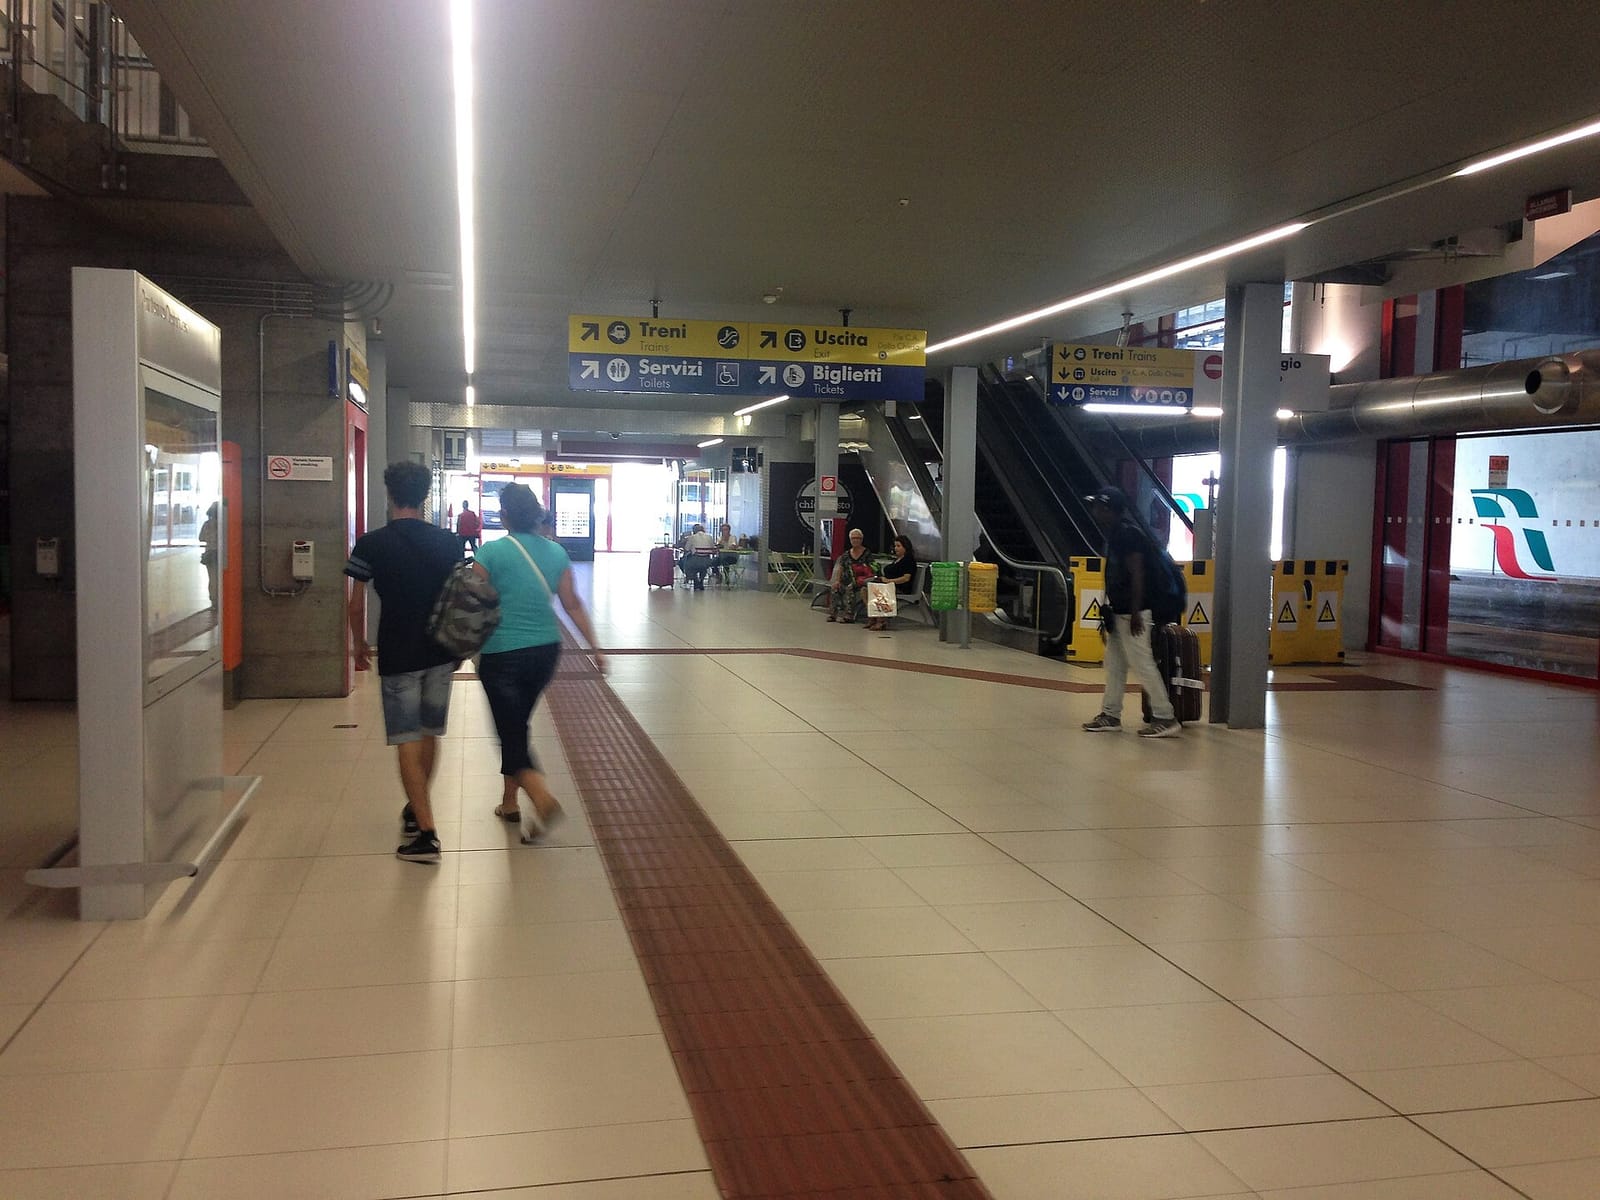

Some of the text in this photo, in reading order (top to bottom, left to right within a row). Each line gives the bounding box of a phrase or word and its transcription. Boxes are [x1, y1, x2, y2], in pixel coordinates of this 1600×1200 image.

[639, 322, 687, 339] Treni
[815, 329, 868, 347] Uscita
[640, 341, 670, 352] Trains
[814, 347, 830, 358] Exit
[1092, 349, 1157, 362] Treni Trains
[638, 358, 703, 377] Servizi
[1280, 356, 1301, 371] gio
[813, 364, 882, 385] Biglietti
[1090, 367, 1117, 377] Uscita
[638, 377, 671, 389] Toilets
[813, 383, 845, 395] Tickets
[1089, 387, 1120, 398] Servizi
